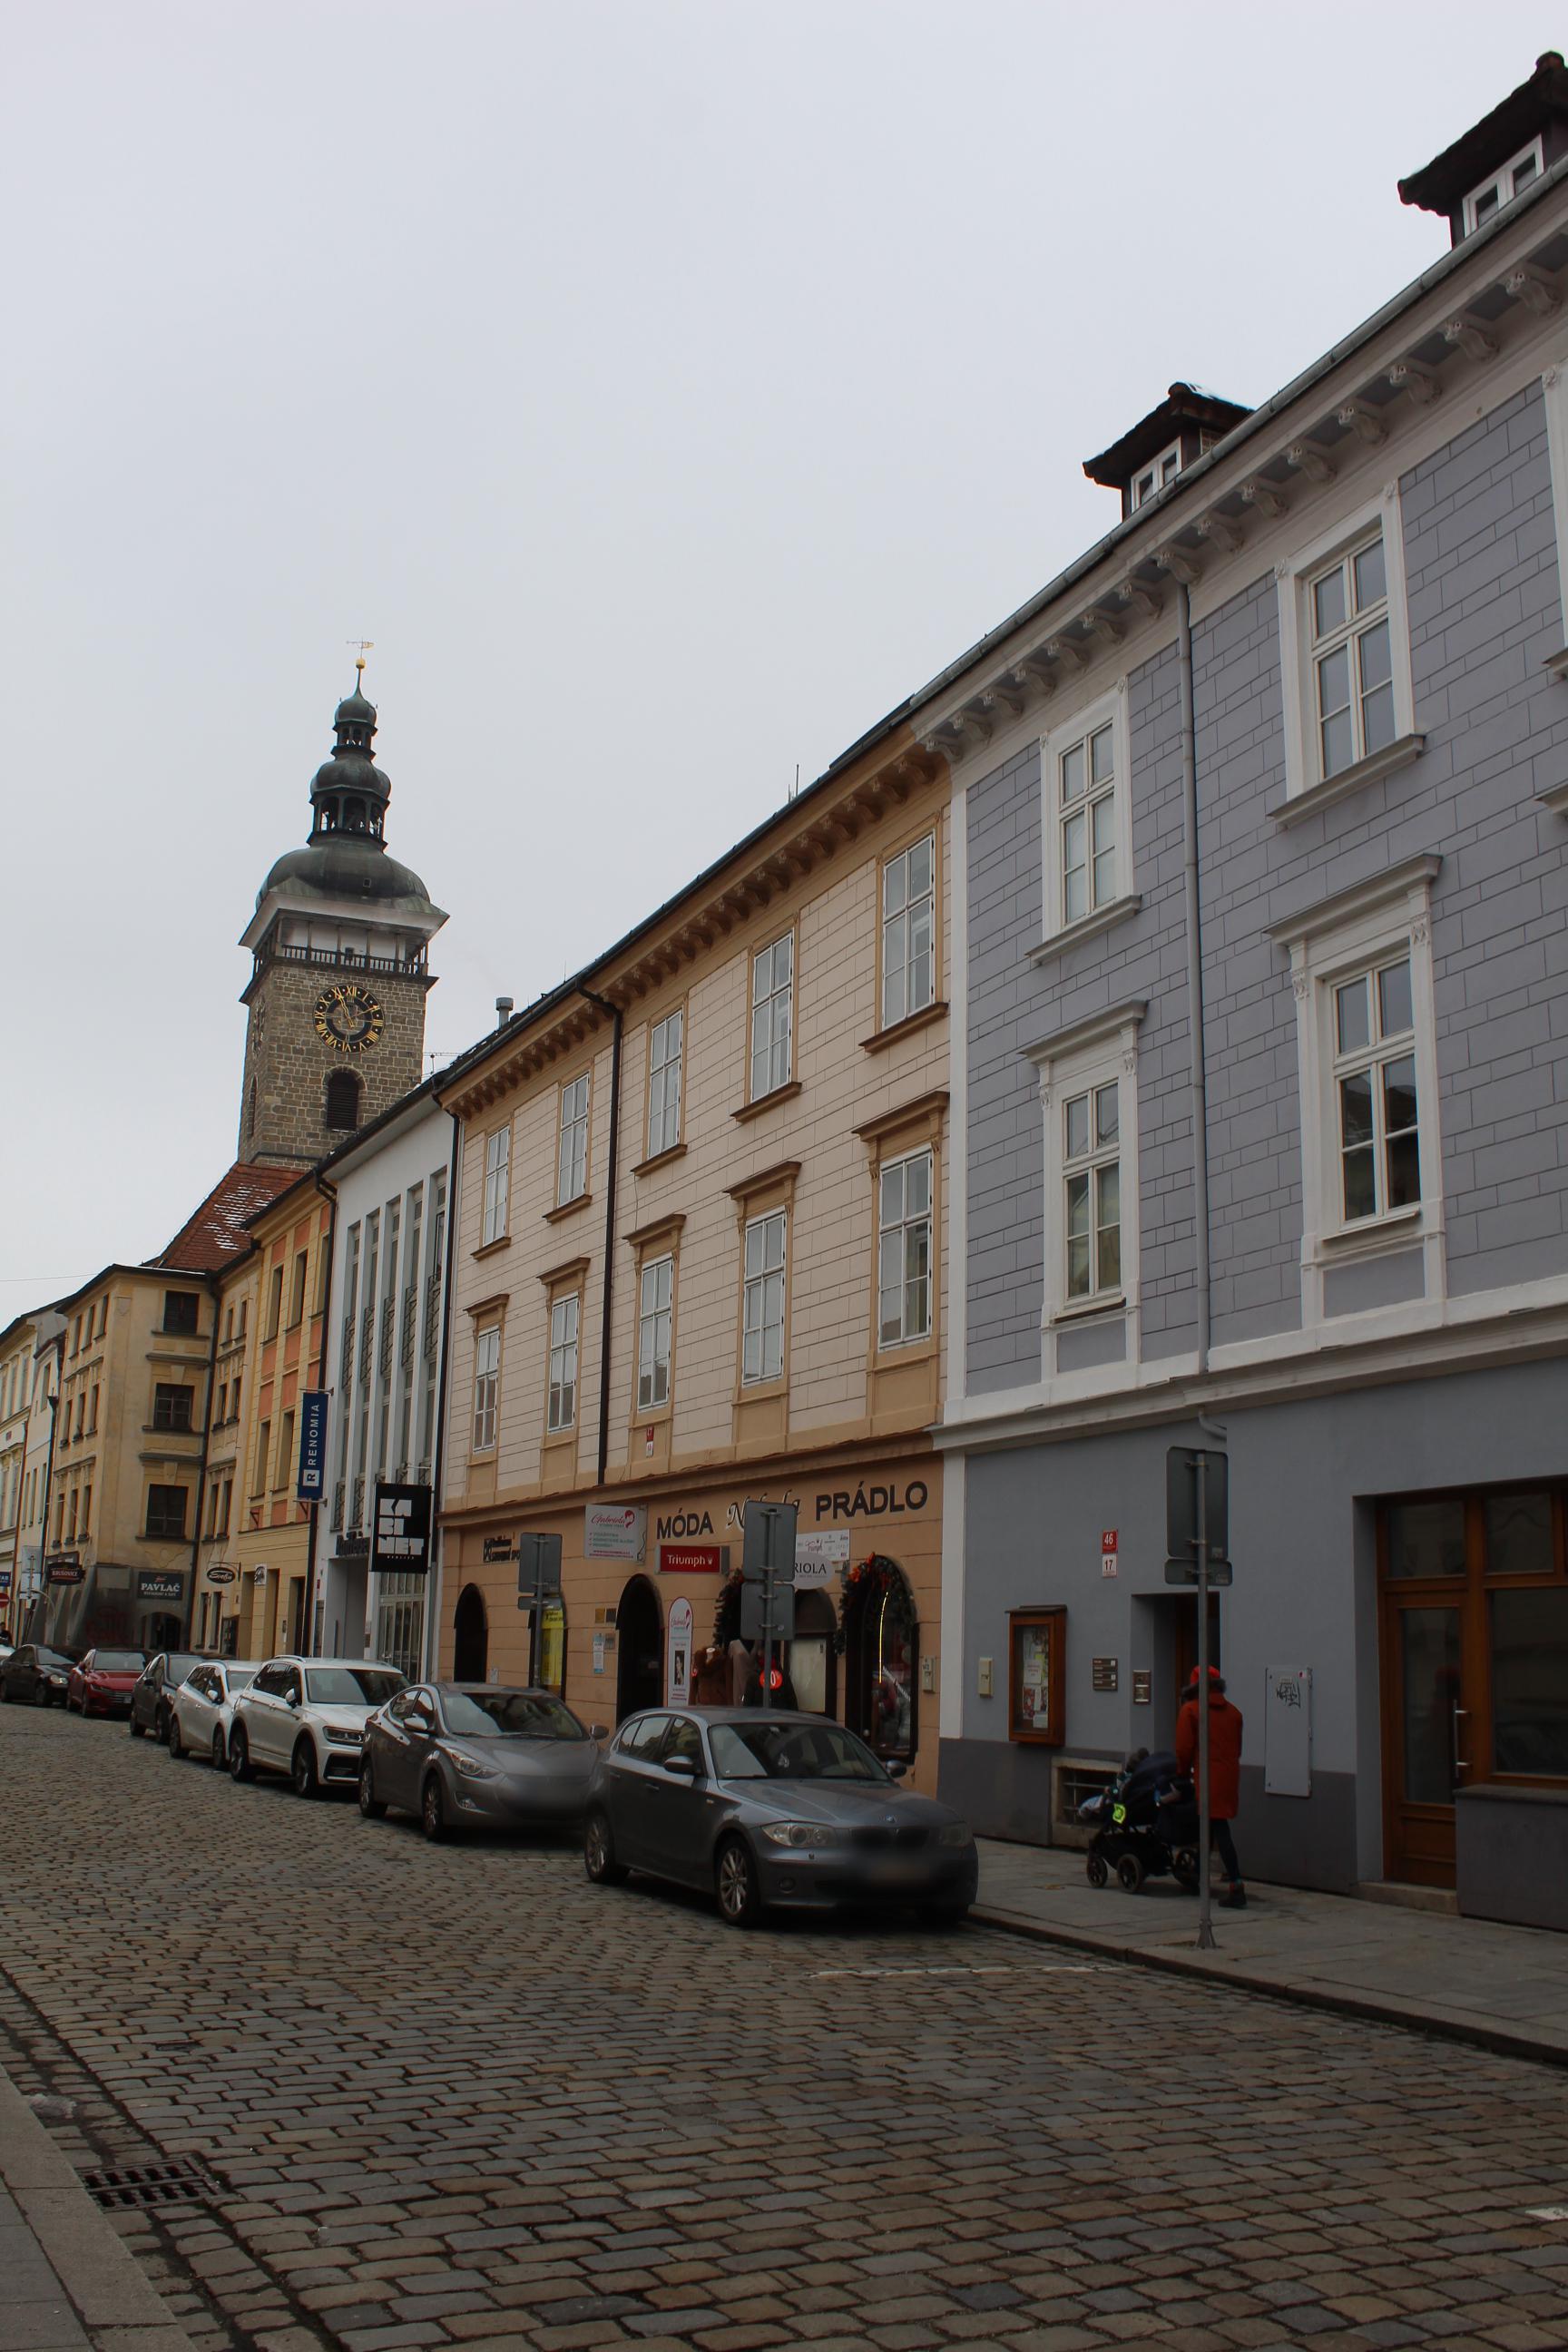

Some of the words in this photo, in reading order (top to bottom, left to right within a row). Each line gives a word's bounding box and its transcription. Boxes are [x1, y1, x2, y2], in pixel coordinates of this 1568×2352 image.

[347, 985, 358, 996] XII
[319, 996, 330, 1006] X
[308, 1404, 320, 1465] RENOMIA
[307, 1473, 316, 1482] R
[816, 1480, 928, 1521] PRÁDLO
[656, 1507, 714, 1540] MÓDA
[1103, 1533, 1113, 1545] 46
[667, 1554, 706, 1567] Triumph
[1105, 1560, 1113, 1571] 17
[794, 1562, 827, 1574] RIOLA
[141, 1583, 181, 1592] PAVLAČ
